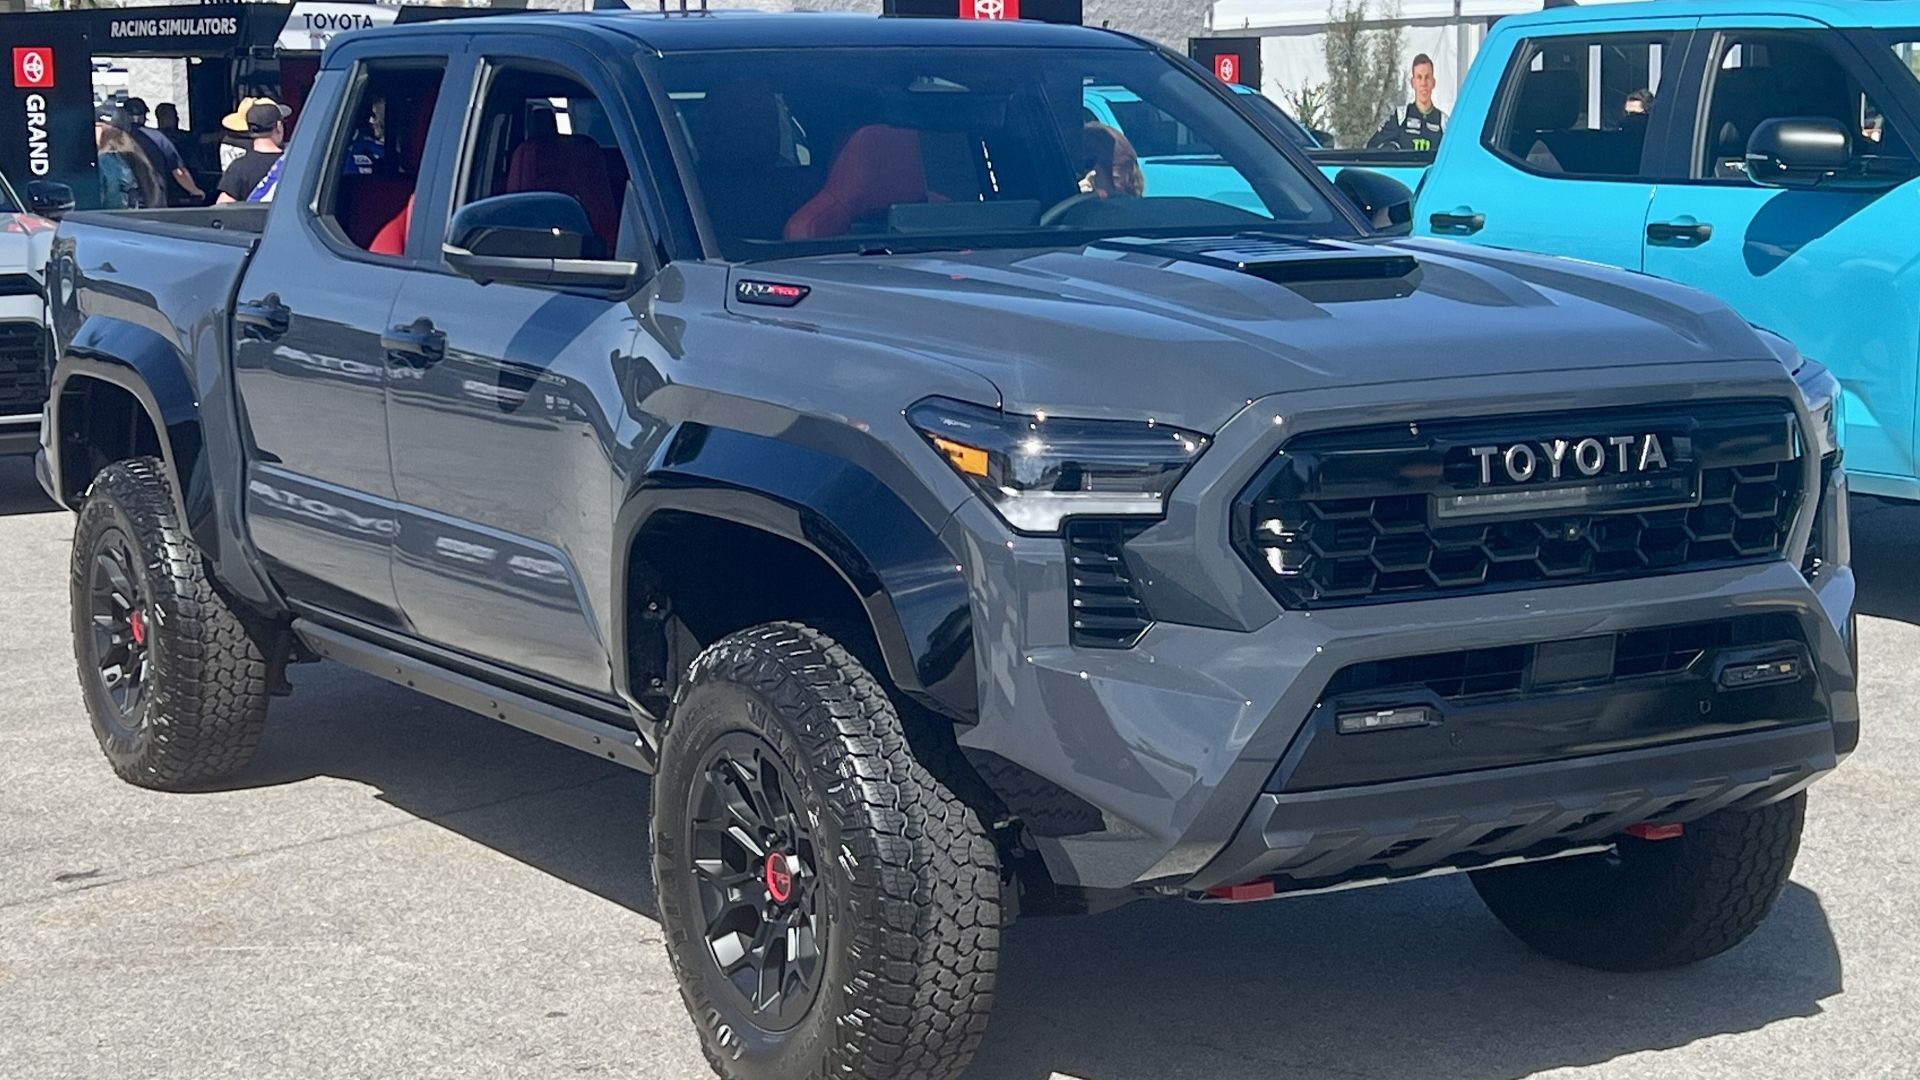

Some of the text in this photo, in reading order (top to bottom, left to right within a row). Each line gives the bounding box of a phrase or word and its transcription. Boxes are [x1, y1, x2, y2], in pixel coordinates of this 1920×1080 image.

[111, 17, 237, 38] RACING SIMULATORS
[303, 13, 374, 30] TOYOTA
[26, 93, 50, 176] GRAND
[1471, 432, 1668, 484] TOYOTA
